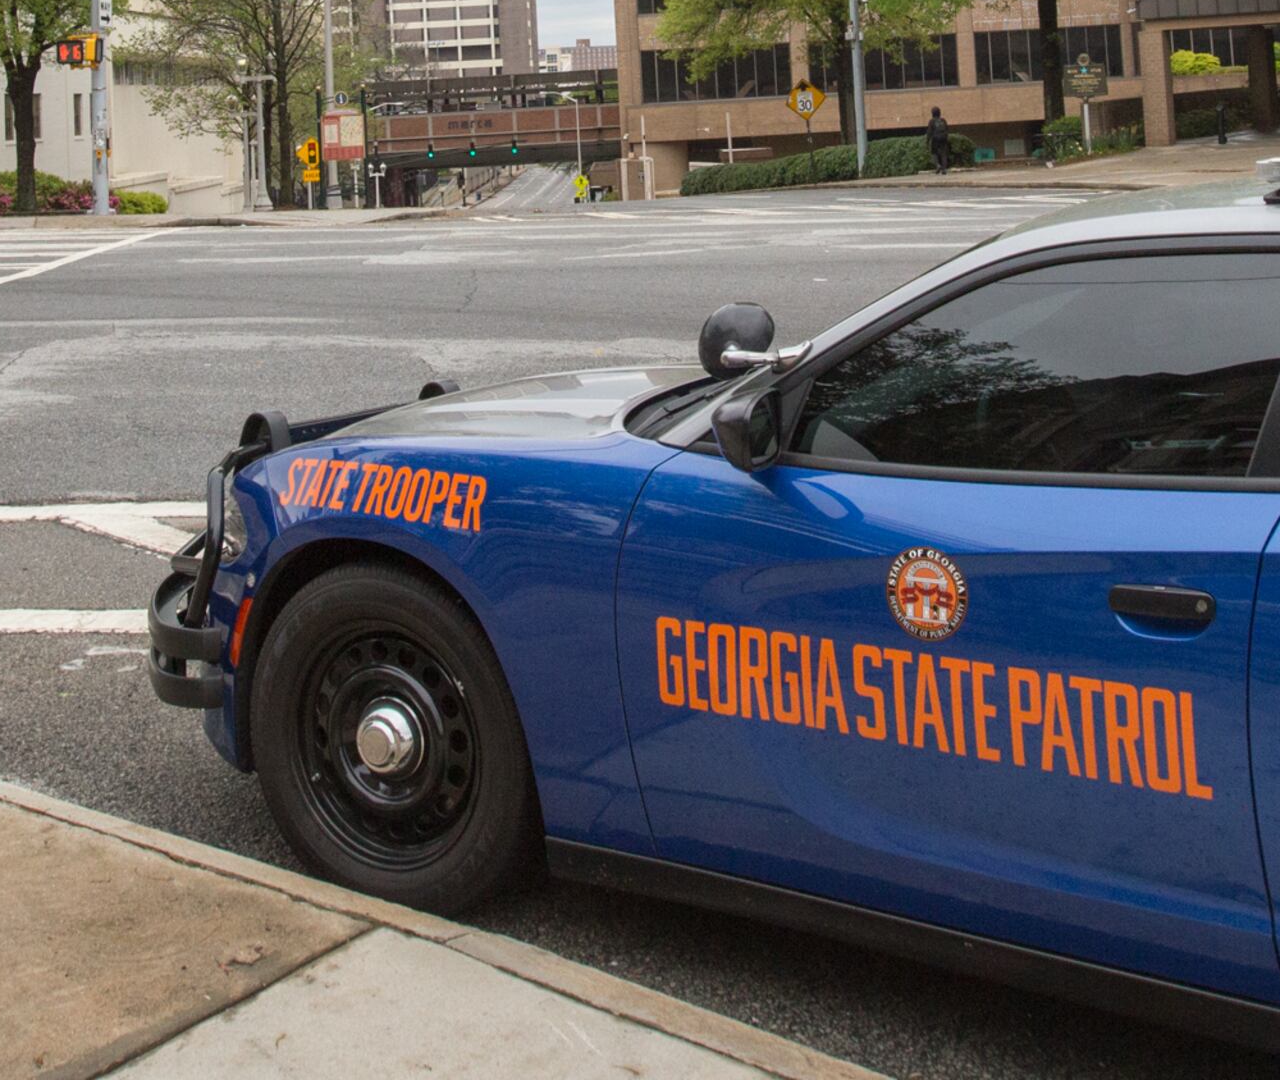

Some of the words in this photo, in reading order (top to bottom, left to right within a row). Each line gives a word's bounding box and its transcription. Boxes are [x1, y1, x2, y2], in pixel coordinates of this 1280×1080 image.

[447, 119, 493, 130] marta
[798, 99, 812, 112] 30
[279, 457, 359, 510] STATE
[351, 463, 487, 532] TROOPER
[888, 555, 908, 587] STATE
[908, 549, 924, 559] OF
[926, 549, 966, 593] GEORGIA
[656, 616, 849, 735] GEORGIA
[852, 643, 1001, 762] STATE
[1007, 666, 1213, 800] PATROL
